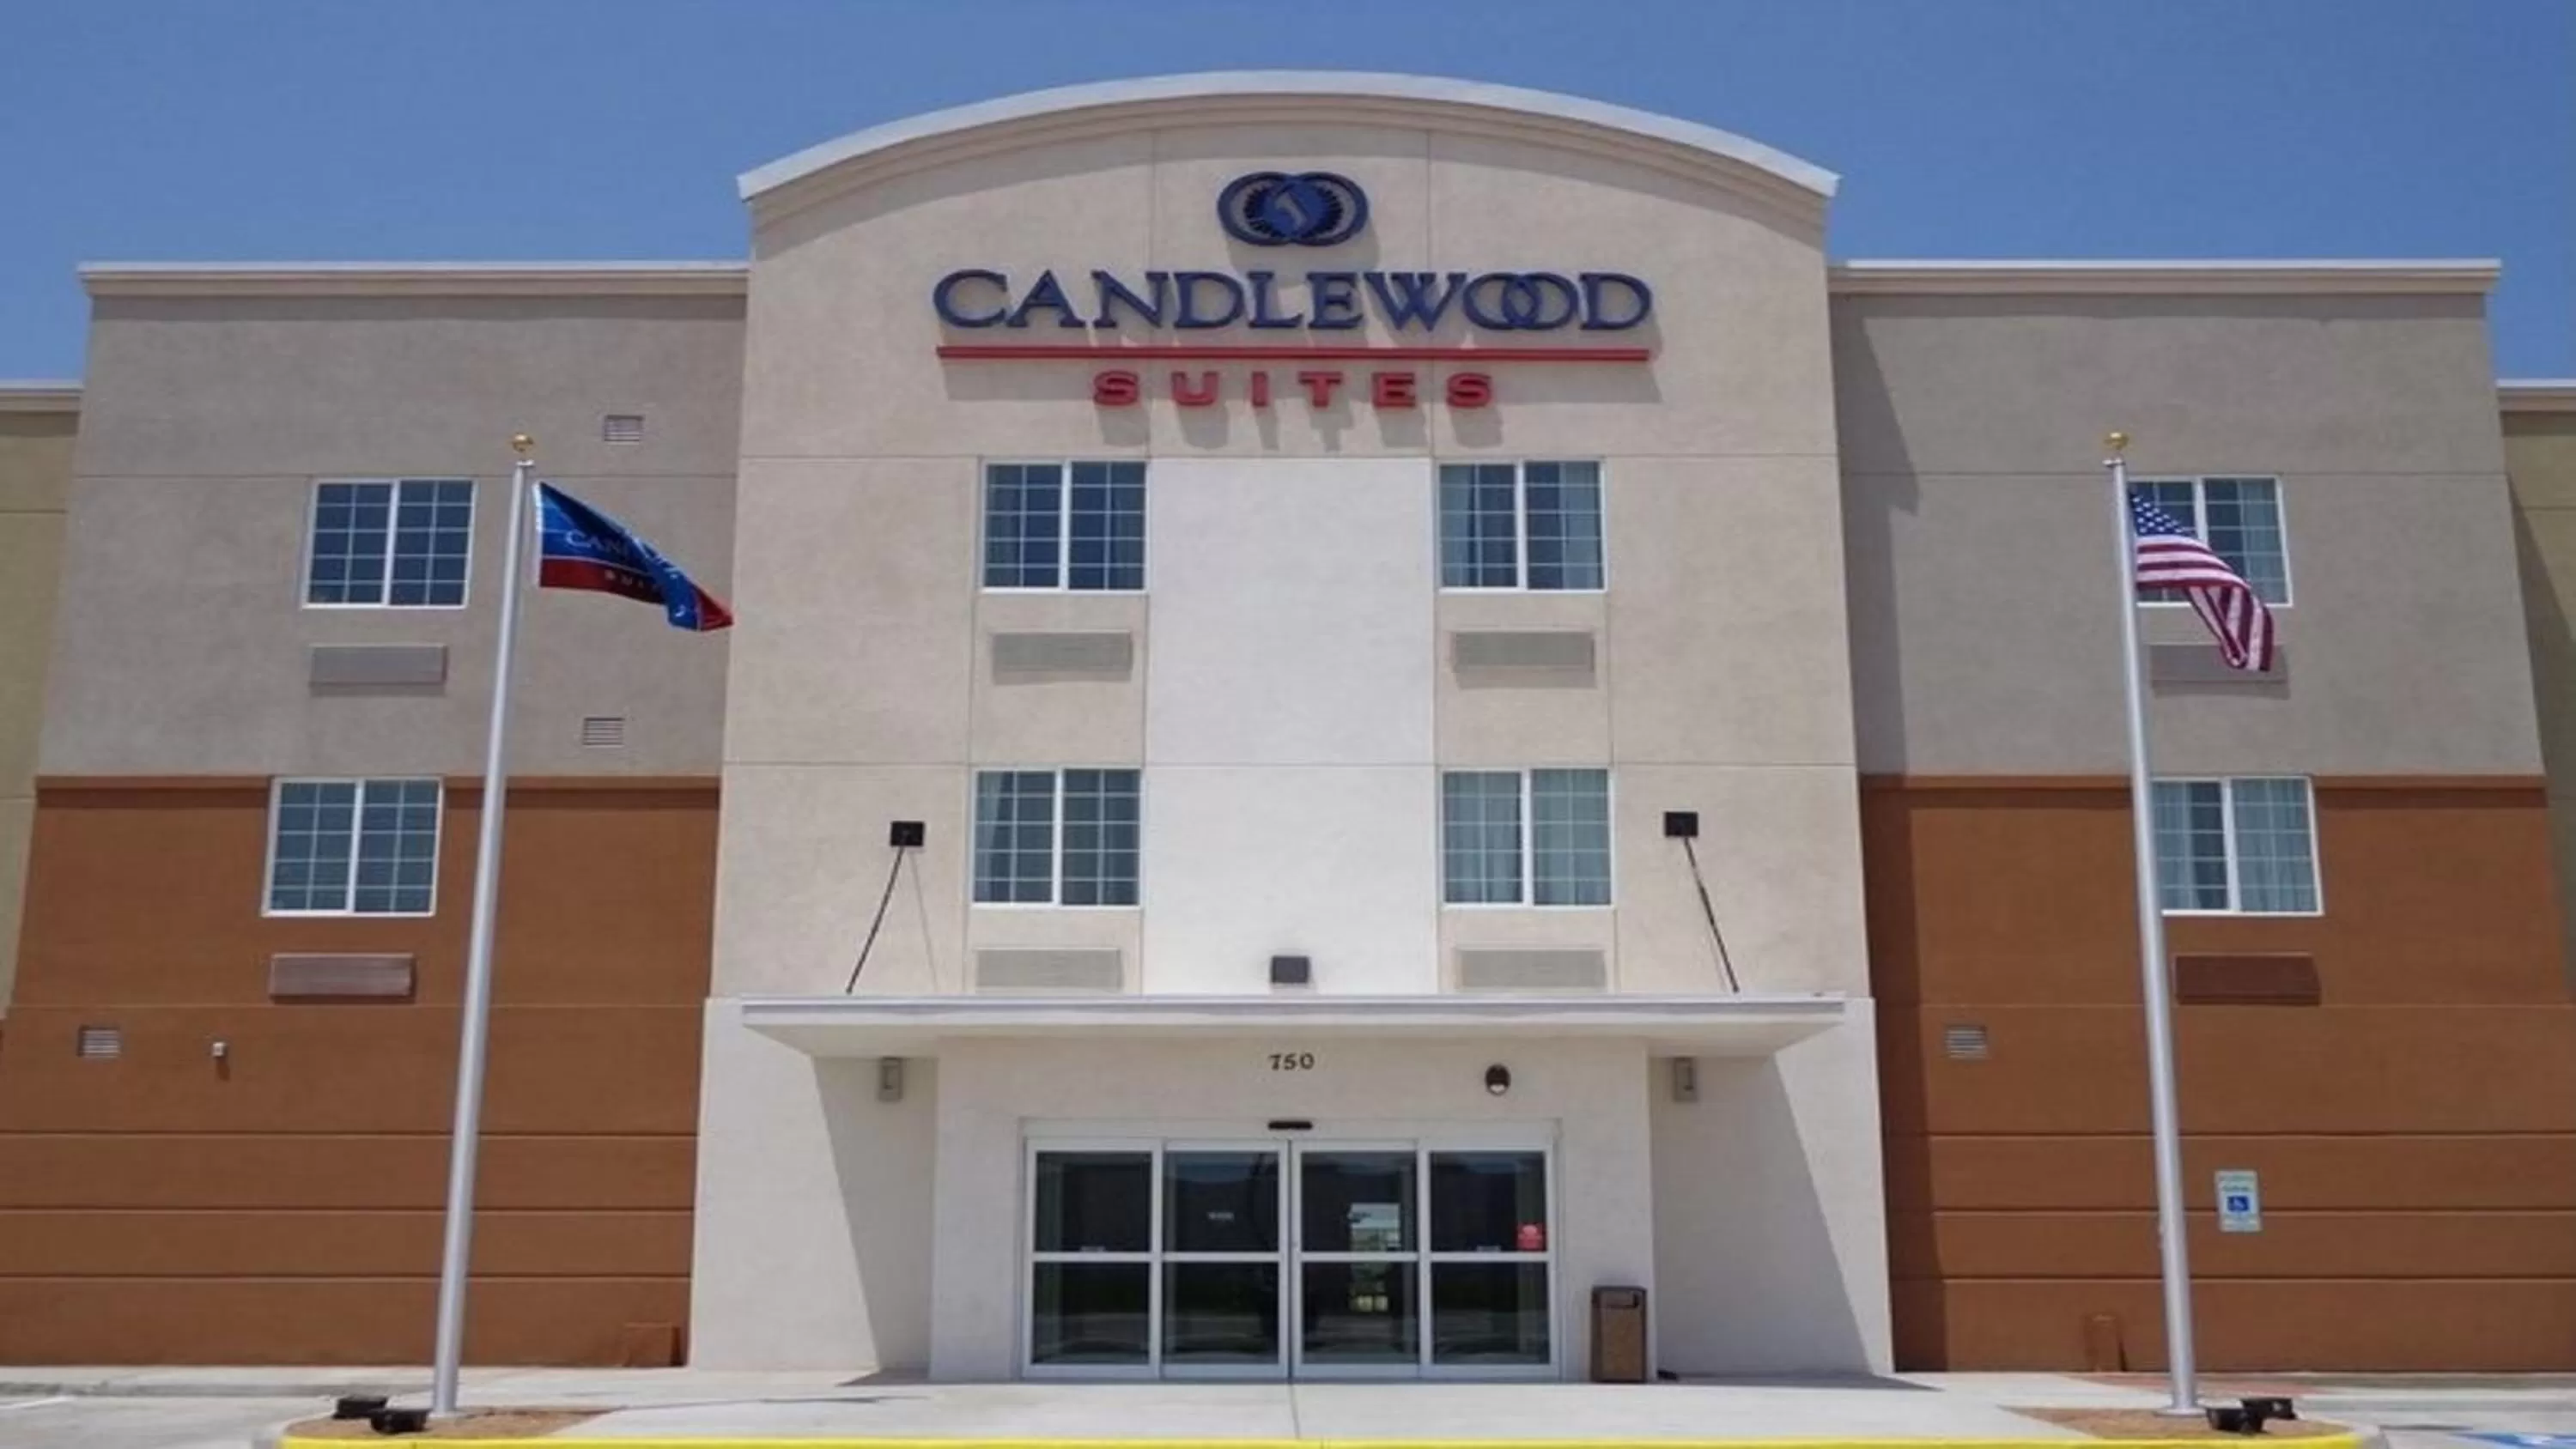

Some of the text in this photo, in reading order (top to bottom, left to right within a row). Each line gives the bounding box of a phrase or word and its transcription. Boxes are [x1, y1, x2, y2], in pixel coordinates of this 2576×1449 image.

[933, 269, 1652, 331] CANDLEWOOD
[1093, 370, 1493, 408] SUITES
[1267, 1052, 1315, 1071] 750
